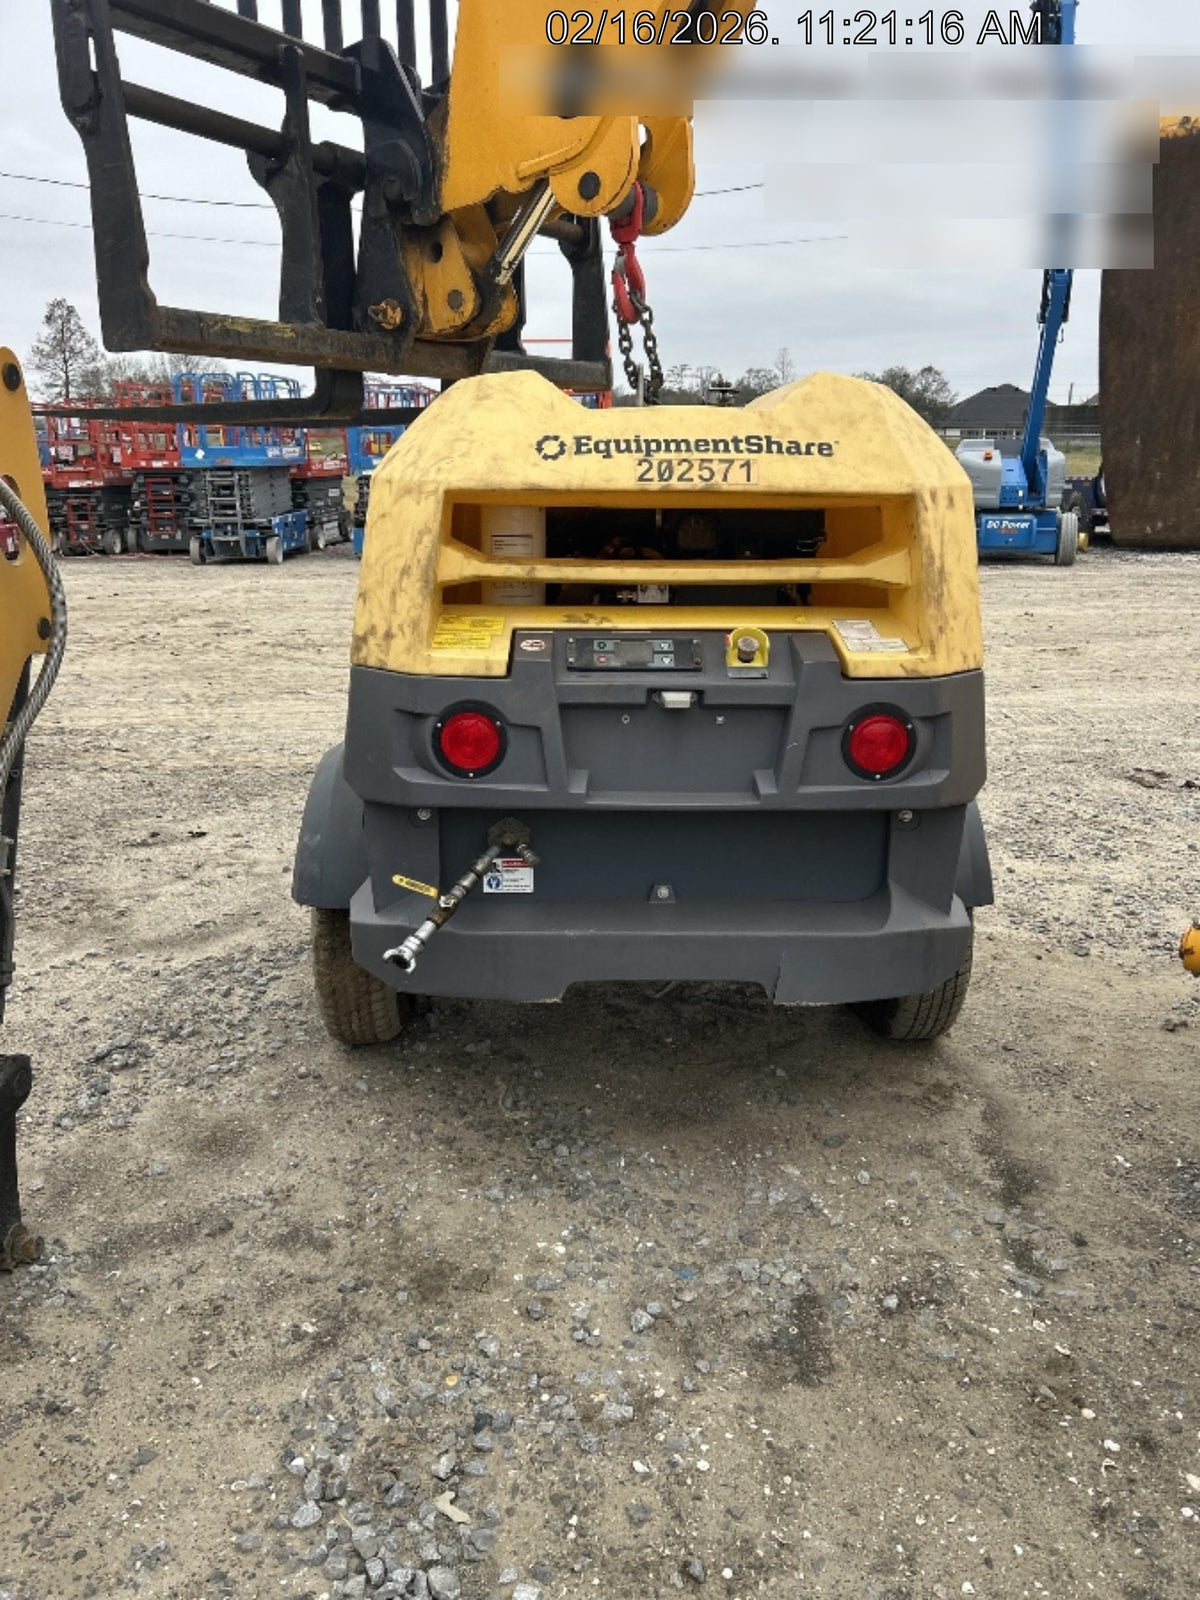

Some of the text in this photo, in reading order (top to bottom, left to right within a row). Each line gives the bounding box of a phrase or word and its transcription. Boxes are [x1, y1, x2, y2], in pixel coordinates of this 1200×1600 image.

[573, 435, 836, 458] EquipmentShare
[635, 458, 754, 483] 202571
[1001, 520, 1030, 529] Power
